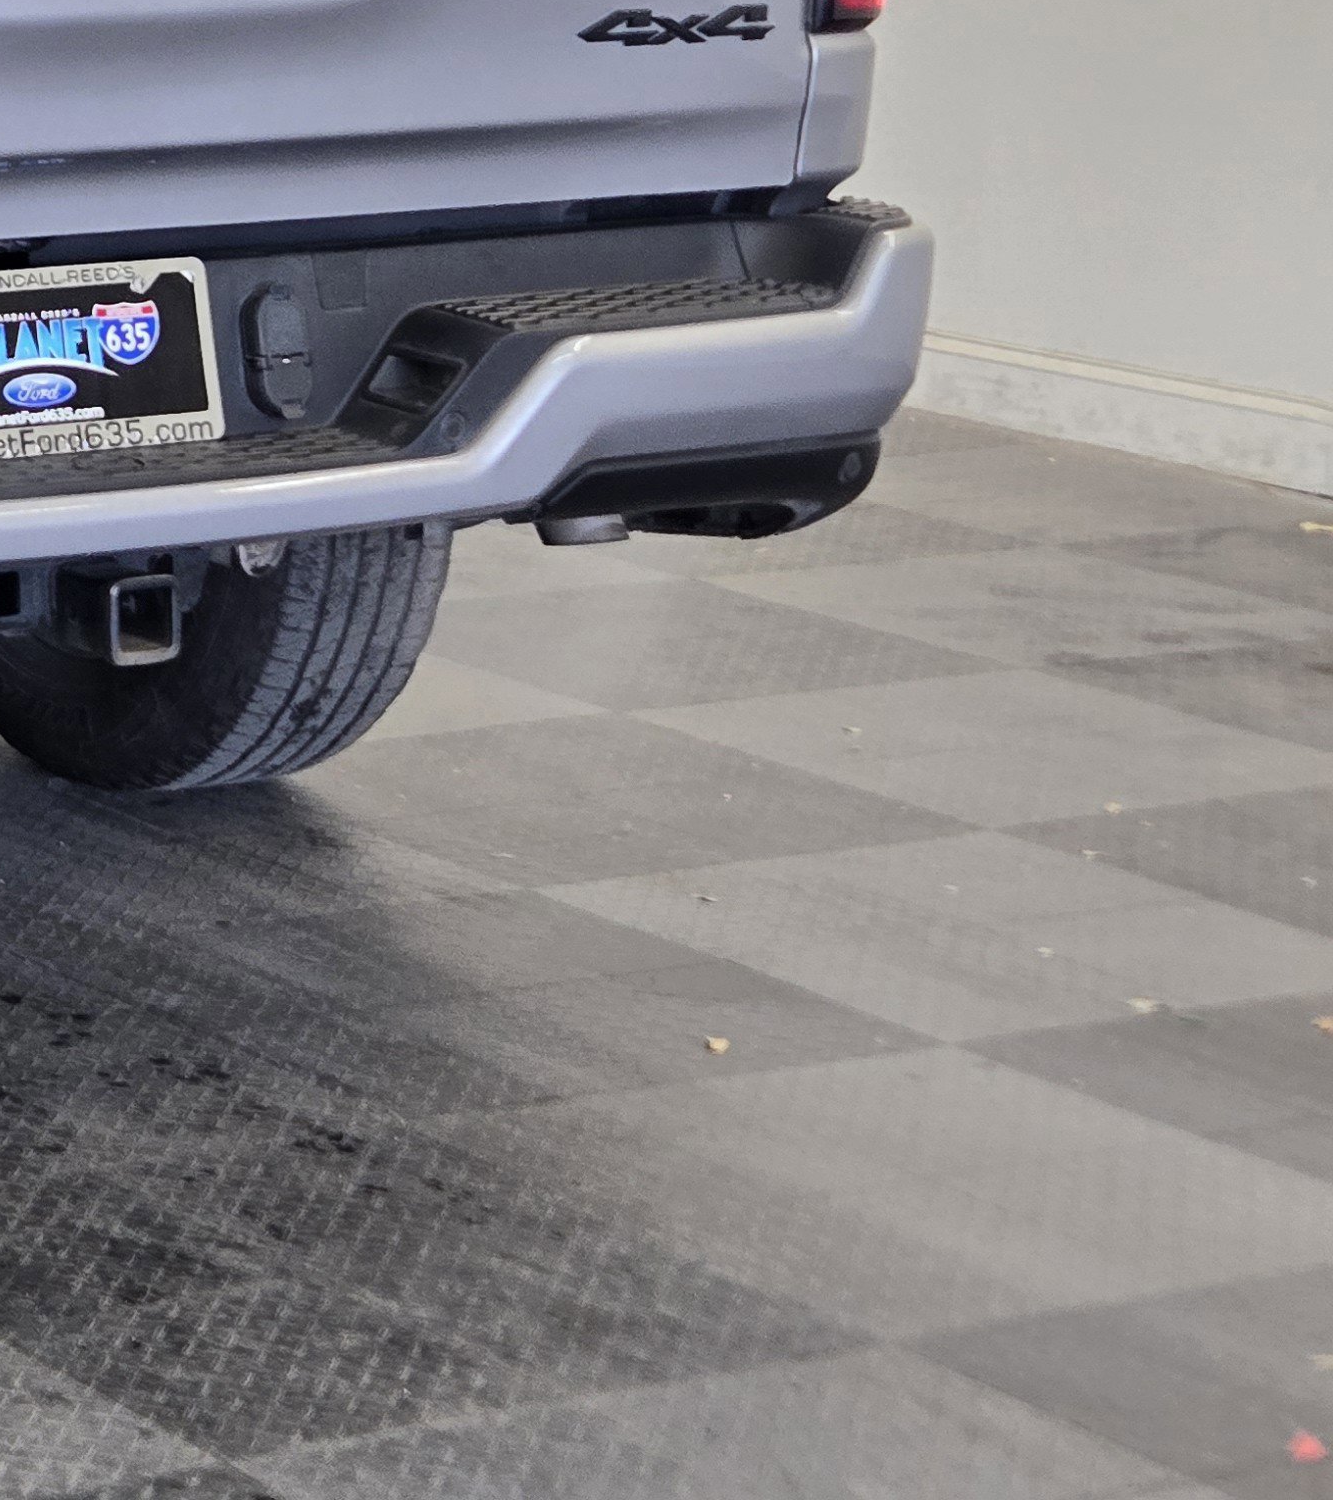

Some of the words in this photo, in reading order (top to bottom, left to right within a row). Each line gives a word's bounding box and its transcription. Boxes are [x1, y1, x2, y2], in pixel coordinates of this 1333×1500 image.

[577, 3, 776, 47] 4x4
[66, 264, 137, 283] REED'S
[105, 322, 151, 354] 635
[17, 378, 62, 401] Ford
